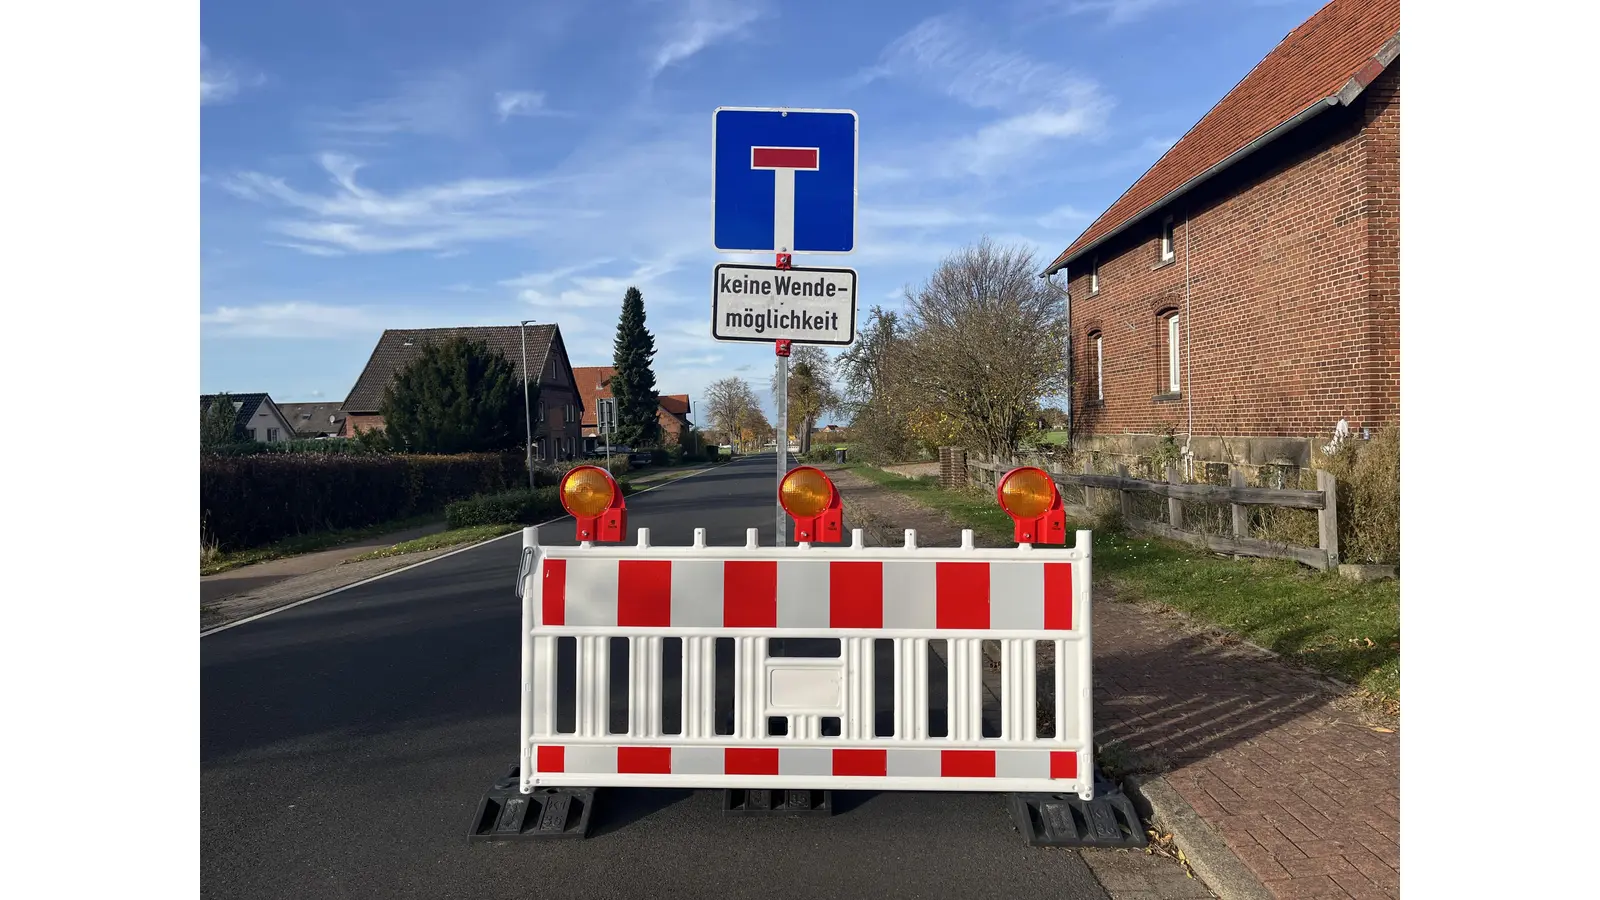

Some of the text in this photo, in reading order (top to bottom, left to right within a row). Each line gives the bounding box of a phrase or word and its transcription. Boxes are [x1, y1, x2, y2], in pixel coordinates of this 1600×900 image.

[720, 273, 848, 298] keine Wende-
[725, 307, 839, 334] möglichkeit
